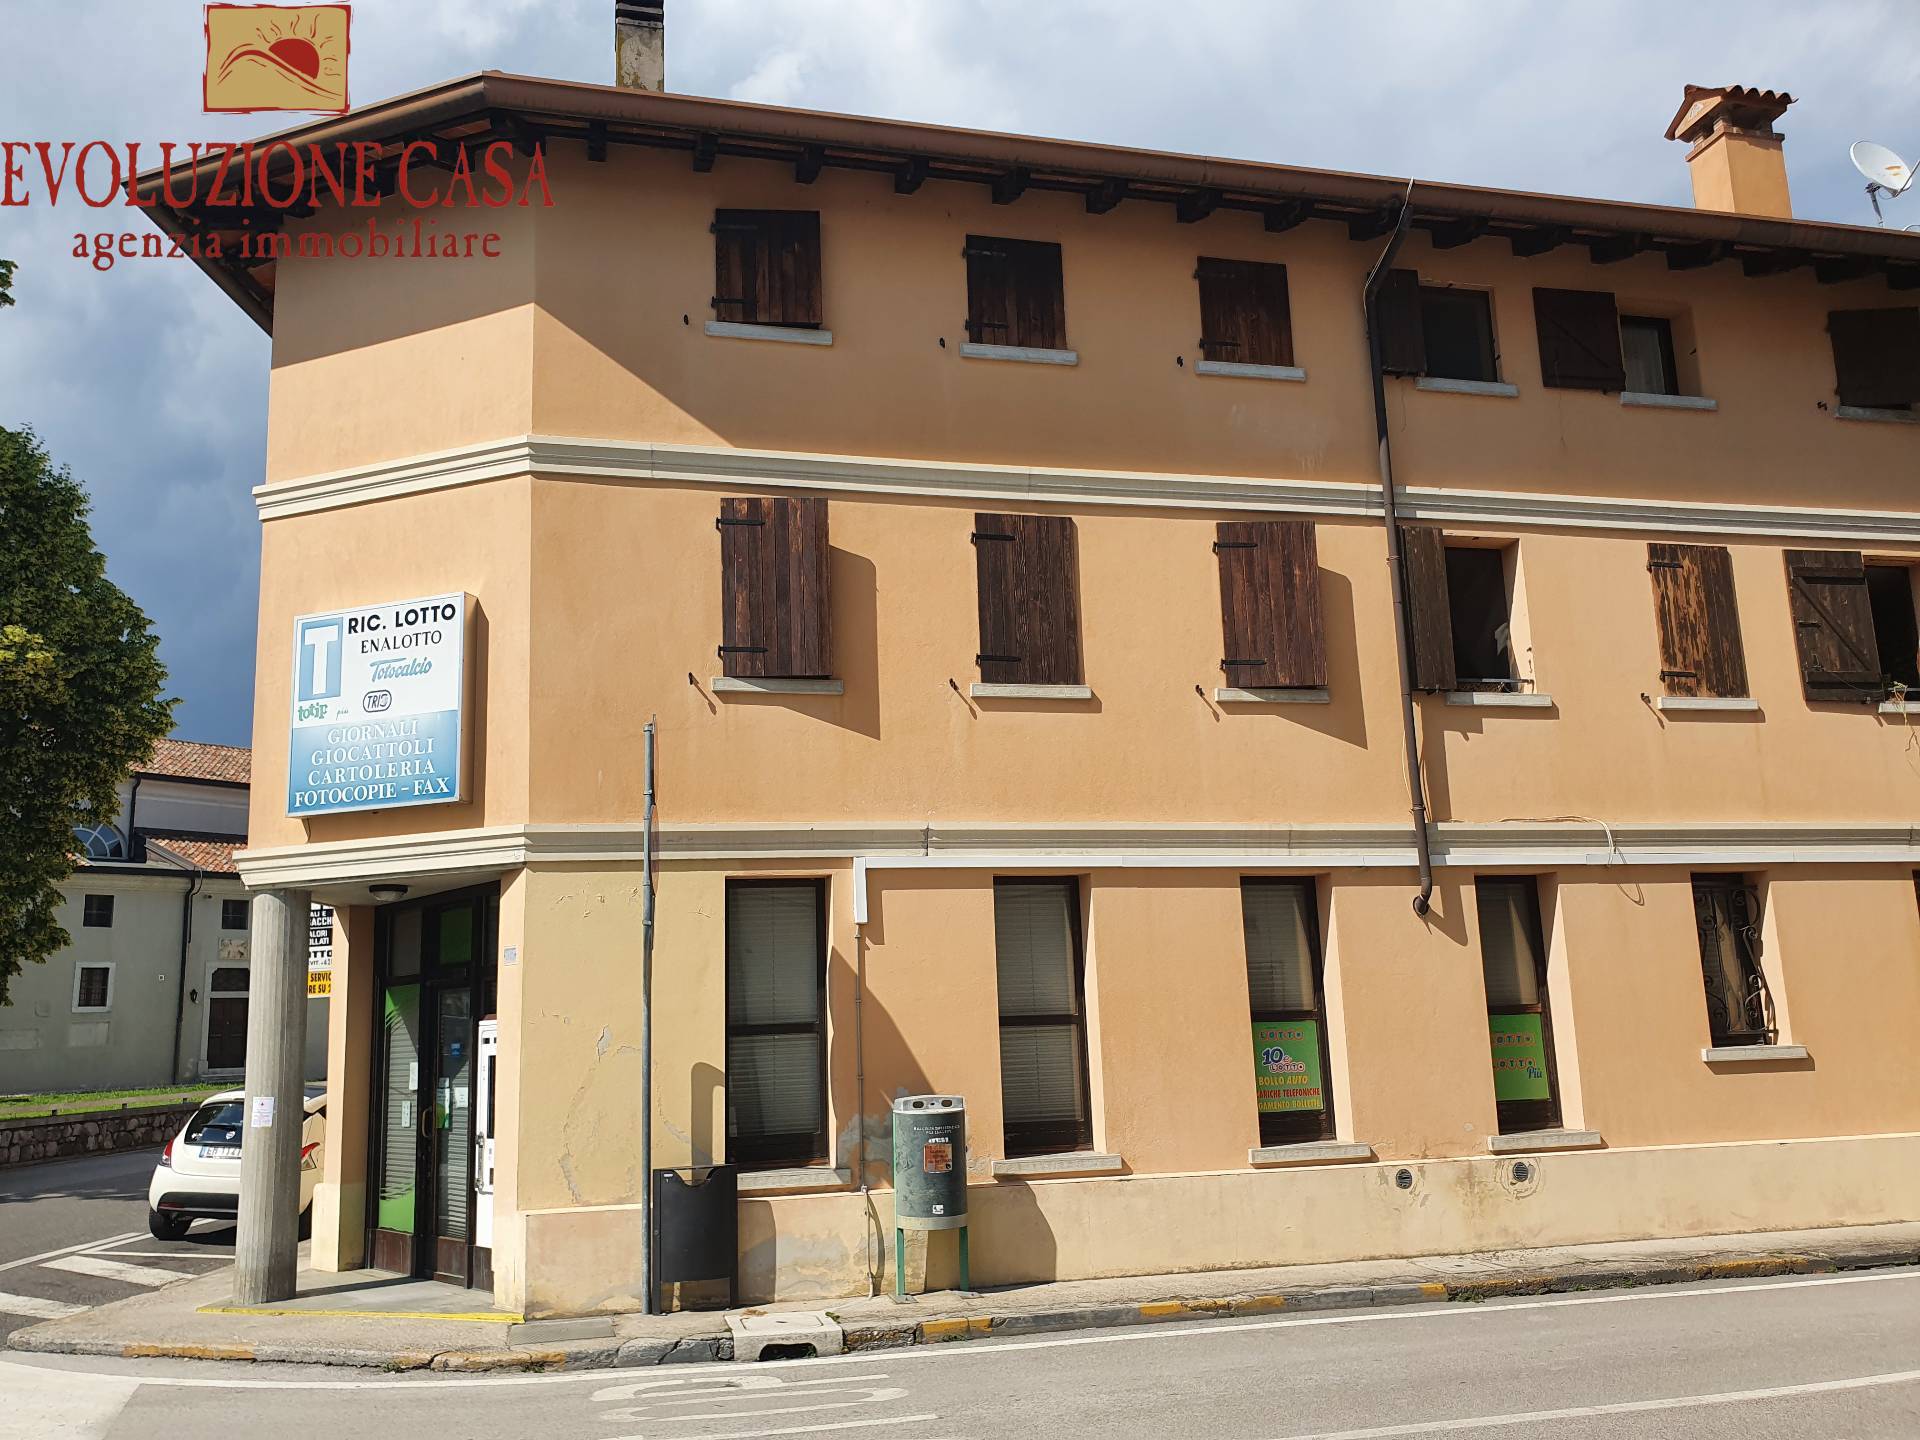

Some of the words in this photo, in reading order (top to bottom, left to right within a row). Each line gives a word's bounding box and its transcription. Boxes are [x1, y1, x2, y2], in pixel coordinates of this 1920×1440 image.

[348, 614, 386, 635] RIC.
[395, 603, 456, 628] LOTTO
[361, 630, 442, 654] ENALOTTO
[369, 656, 433, 683] Totocalcio
[298, 702, 328, 721] totip
[328, 719, 418, 745] GIORNALI
[311, 738, 434, 766] GIOCATTOLI
[308, 759, 437, 786] CARTOLERIA
[294, 782, 397, 808] FOTOCOPIE
[413, 777, 449, 797] FAX
[1263, 1047, 1284, 1065] 10
[1259, 1076, 1284, 1086] BOLLO
[1287, 1075, 1308, 1085] AUTO
[1283, 1087, 1320, 1098] TELEFONICHE
